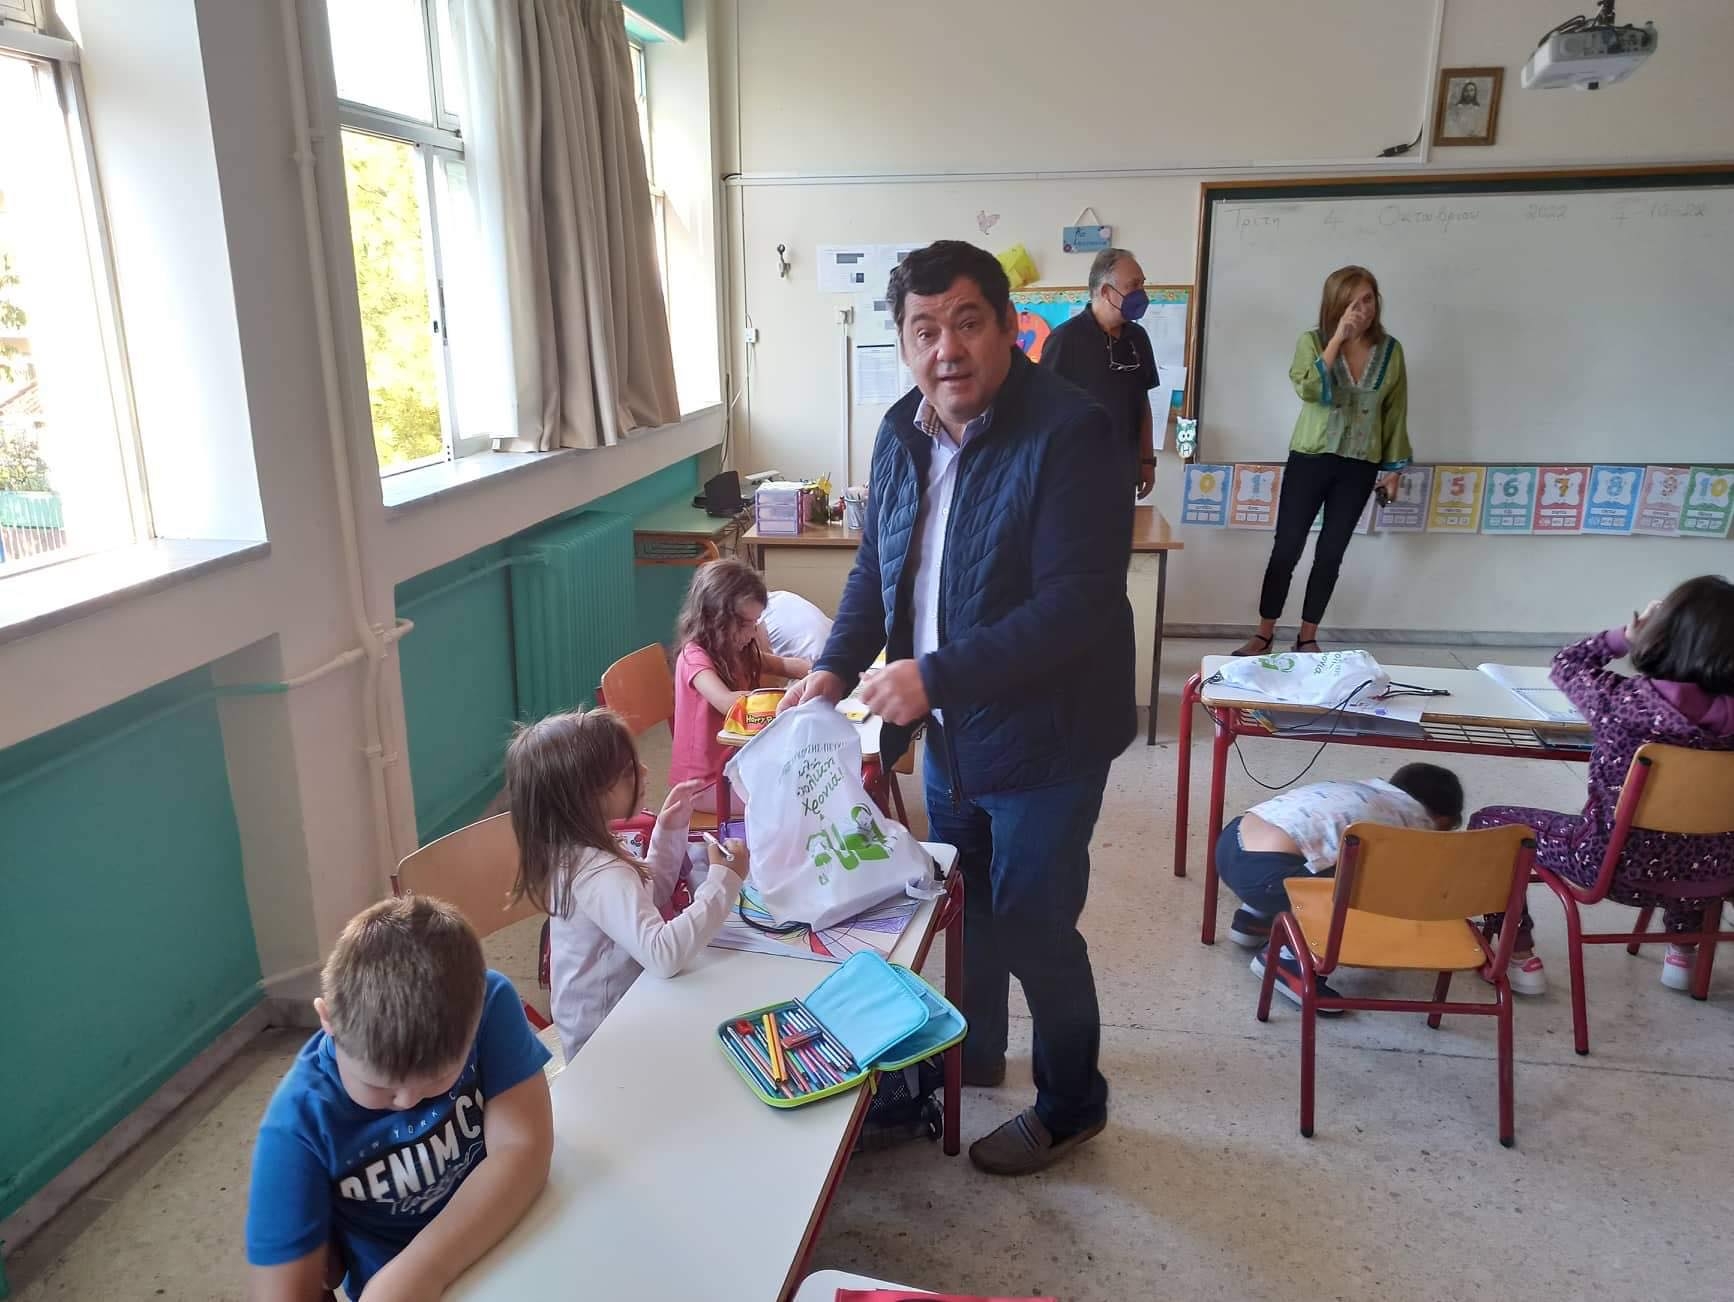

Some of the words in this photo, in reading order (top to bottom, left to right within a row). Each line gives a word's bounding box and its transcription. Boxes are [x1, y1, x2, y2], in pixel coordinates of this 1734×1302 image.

[1450, 476, 1465, 496] 5
[1503, 477, 1519, 498] 6
[1555, 477, 1569, 498] 7
[1607, 475, 1623, 497] 8
[1662, 476, 1678, 497] 9
[1701, 477, 1728, 498] 10
[393, 1108, 441, 1138] YORK
